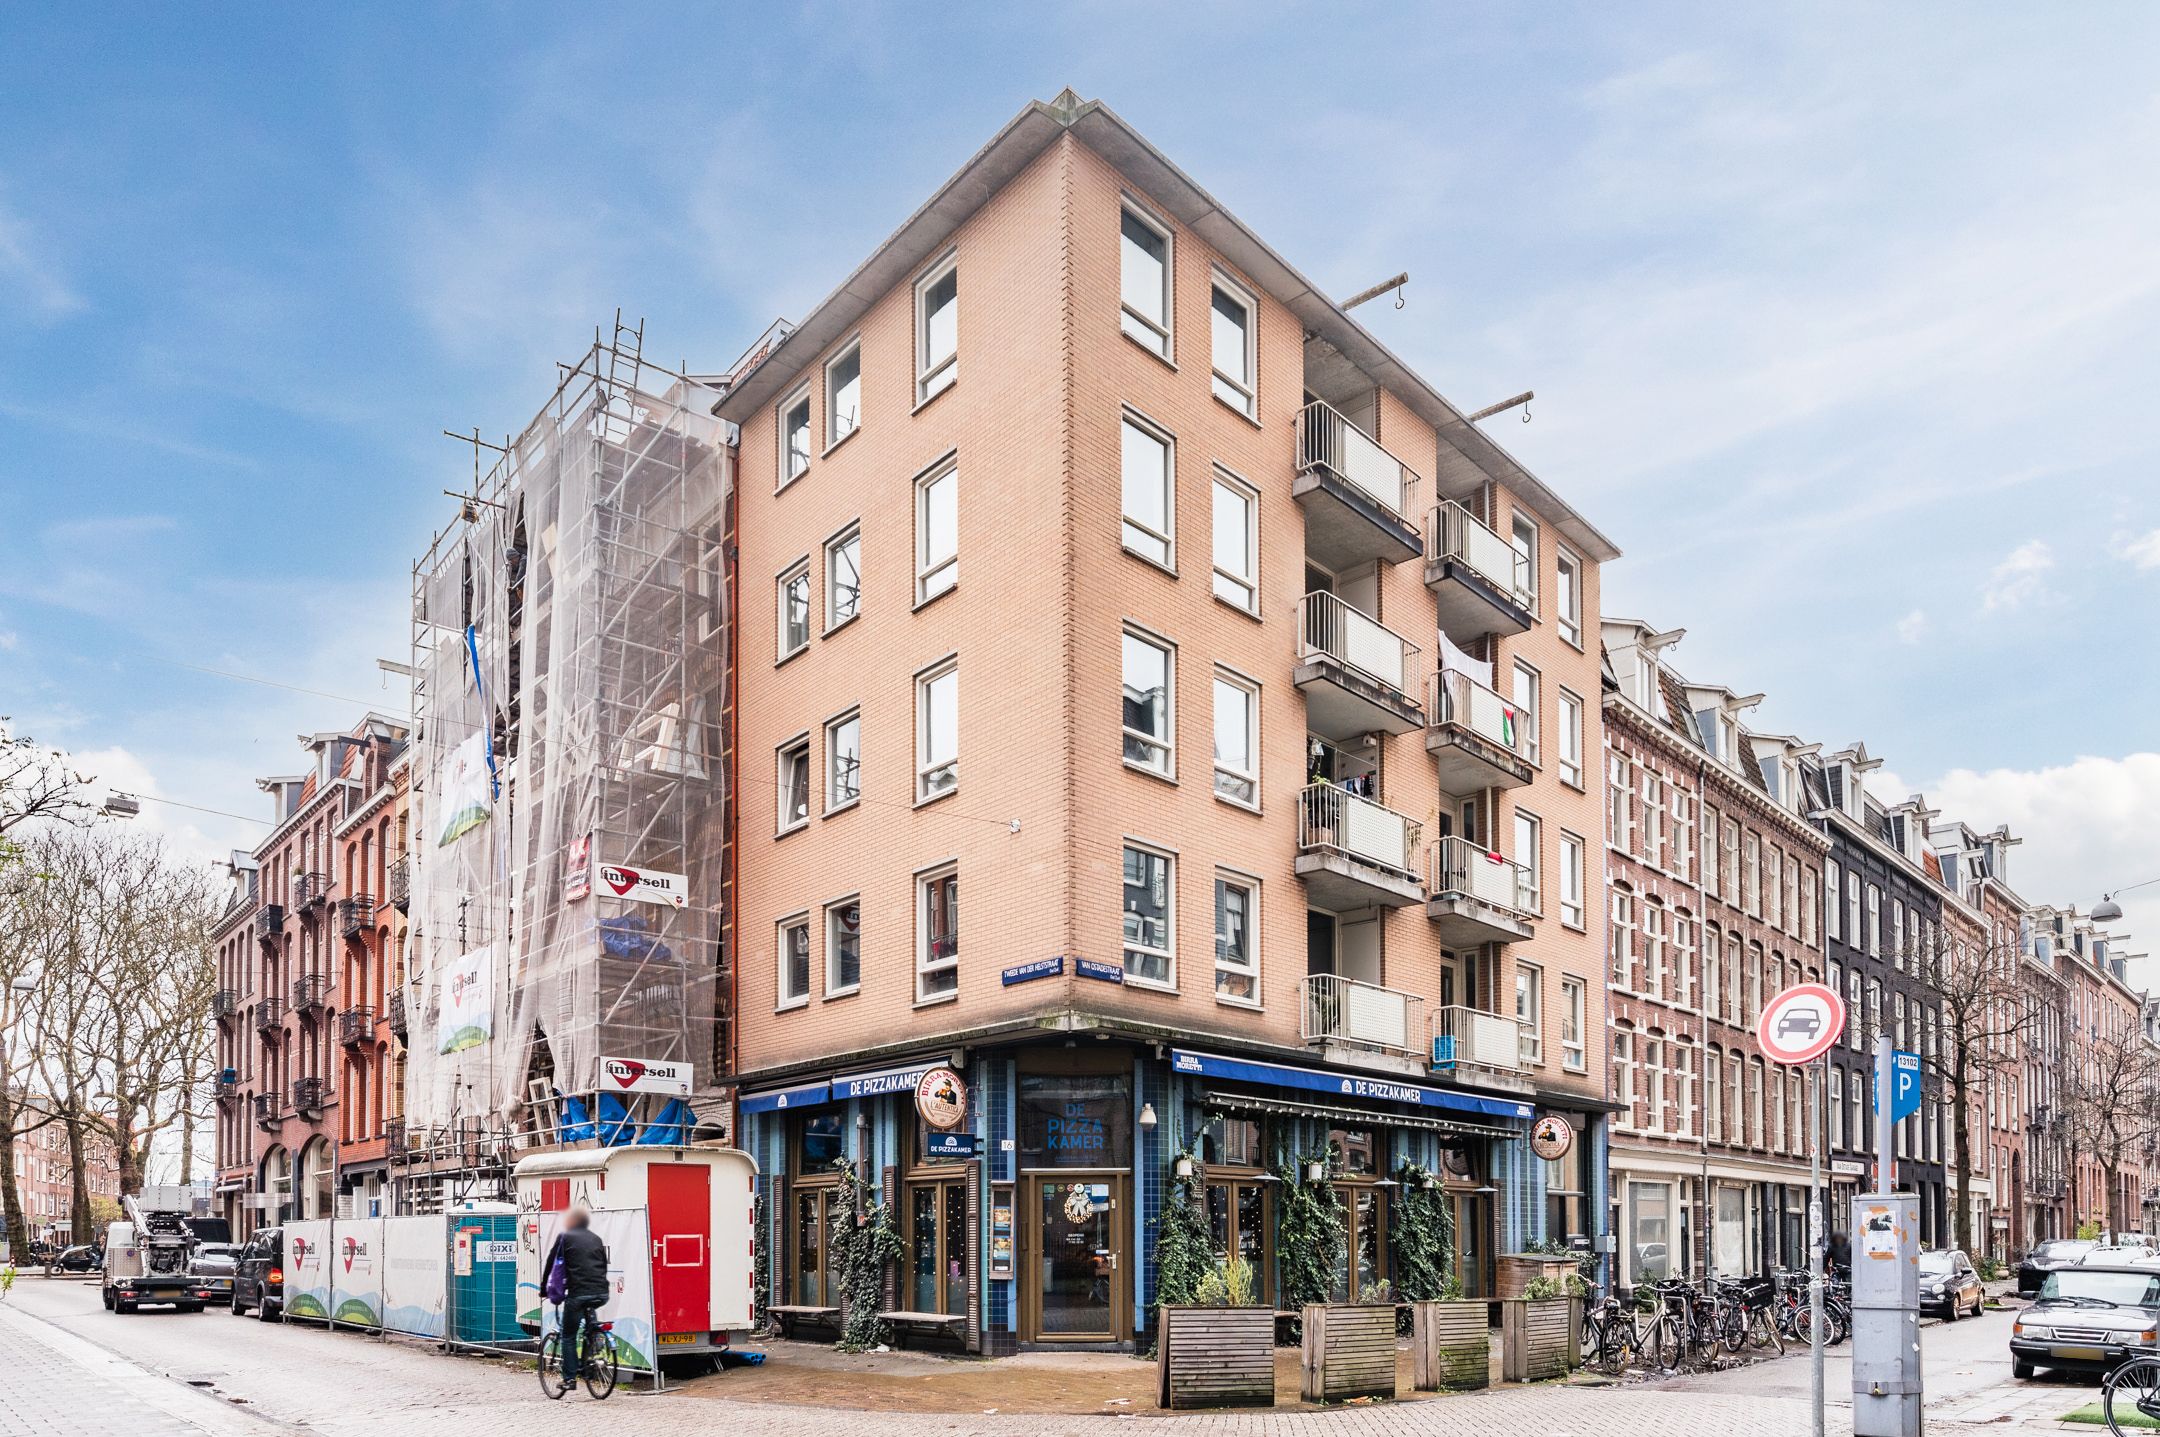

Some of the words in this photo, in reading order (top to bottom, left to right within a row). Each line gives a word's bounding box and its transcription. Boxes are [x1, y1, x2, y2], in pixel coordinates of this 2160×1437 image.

[602, 869, 671, 889] intersell
[1004, 969, 1019, 978] TWEEDE
[1019, 967, 1027, 976] VAN
[1027, 964, 1035, 974] DER
[1081, 961, 1091, 970] VAN
[1091, 962, 1121, 975] OSTADESTRAAT
[1899, 1057, 1918, 1068] 13102
[607, 1063, 677, 1078] intersell
[850, 1080, 862, 1096] DE
[921, 1072, 942, 1097] BIRRA
[1355, 1081, 1367, 1095] DE
[1369, 1083, 1421, 1103] PIZZAKAMER
[1899, 1072, 1912, 1101] P
[1065, 1103, 1086, 1117] DE
[1047, 1119, 1104, 1134] PIZZA
[1047, 1135, 1105, 1150] KAMER
